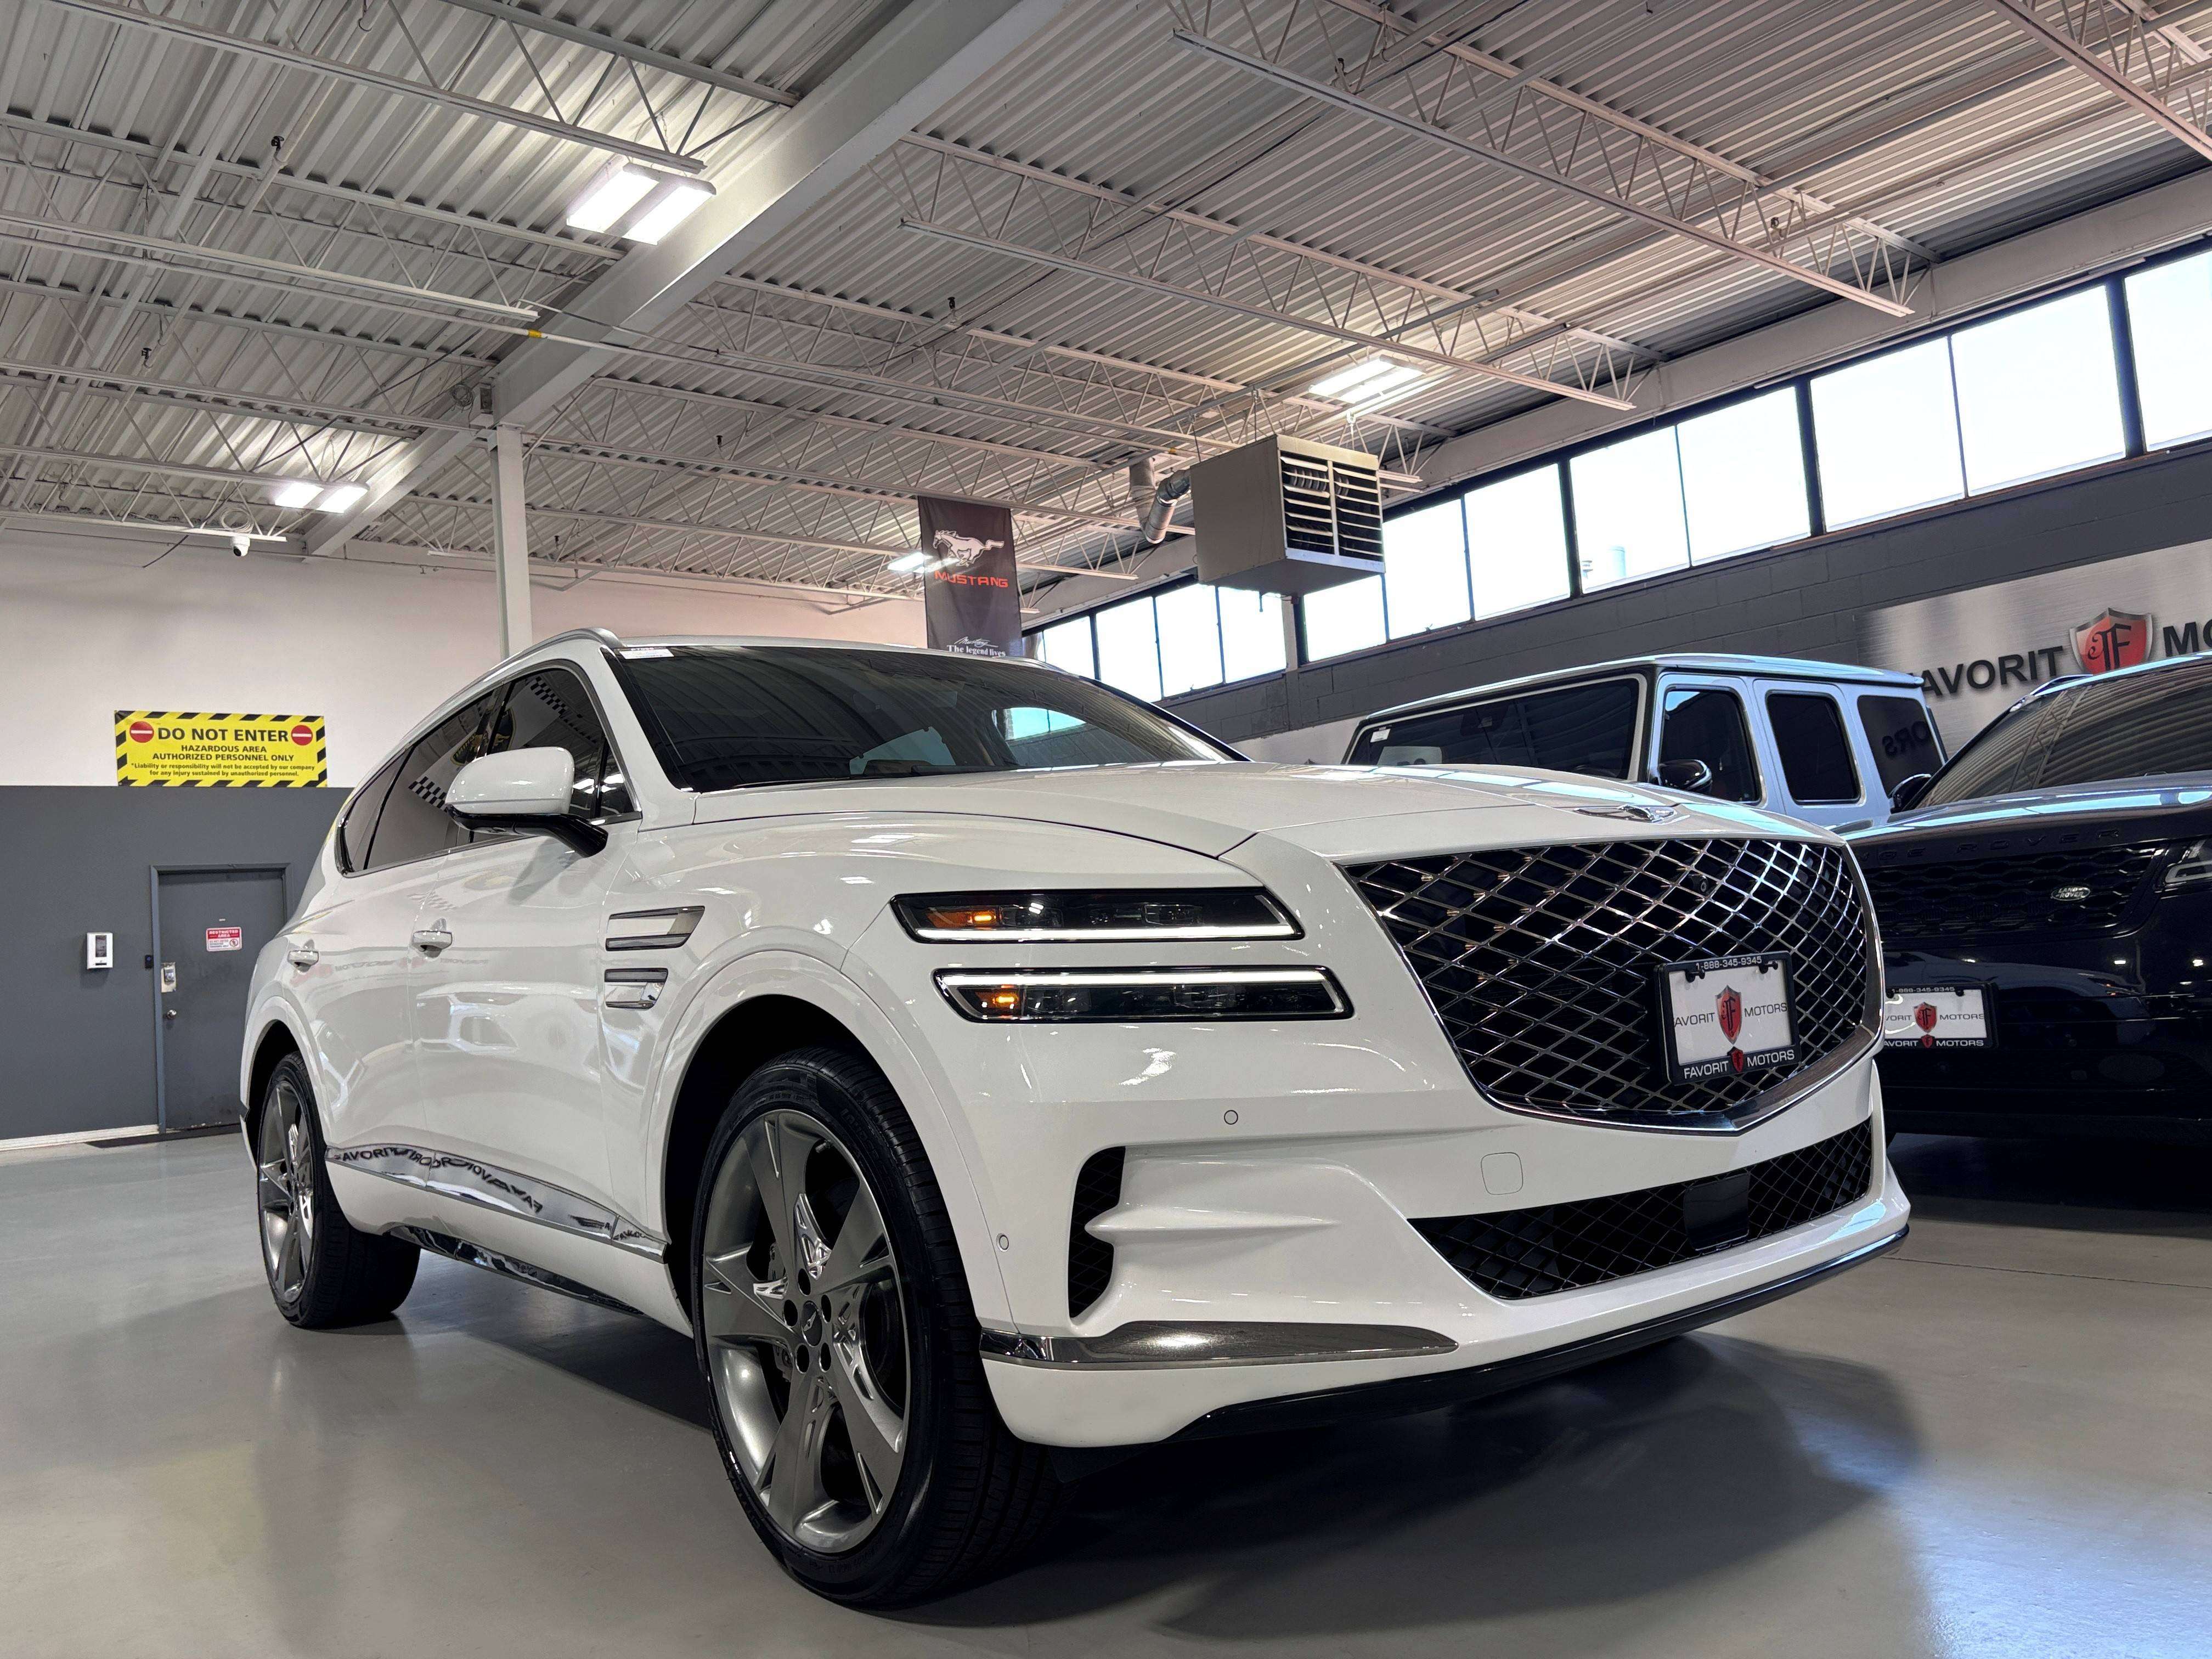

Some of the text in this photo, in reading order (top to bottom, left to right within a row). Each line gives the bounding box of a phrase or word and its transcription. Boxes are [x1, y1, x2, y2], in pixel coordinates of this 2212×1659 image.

[934, 570, 1008, 588] MUSTANG
[946, 645, 1006, 657] The legend lives
[1908, 646, 2063, 696] AVORIT
[158, 727, 289, 742] DO NOT ENTER
[1696, 956, 1762, 970] 1-888-345-9345
[1674, 1012, 1715, 1027] AVORIT
[1744, 1002, 1787, 1017] MOTORS
[1684, 1049, 1795, 1079] FAVORIT MOTORS
